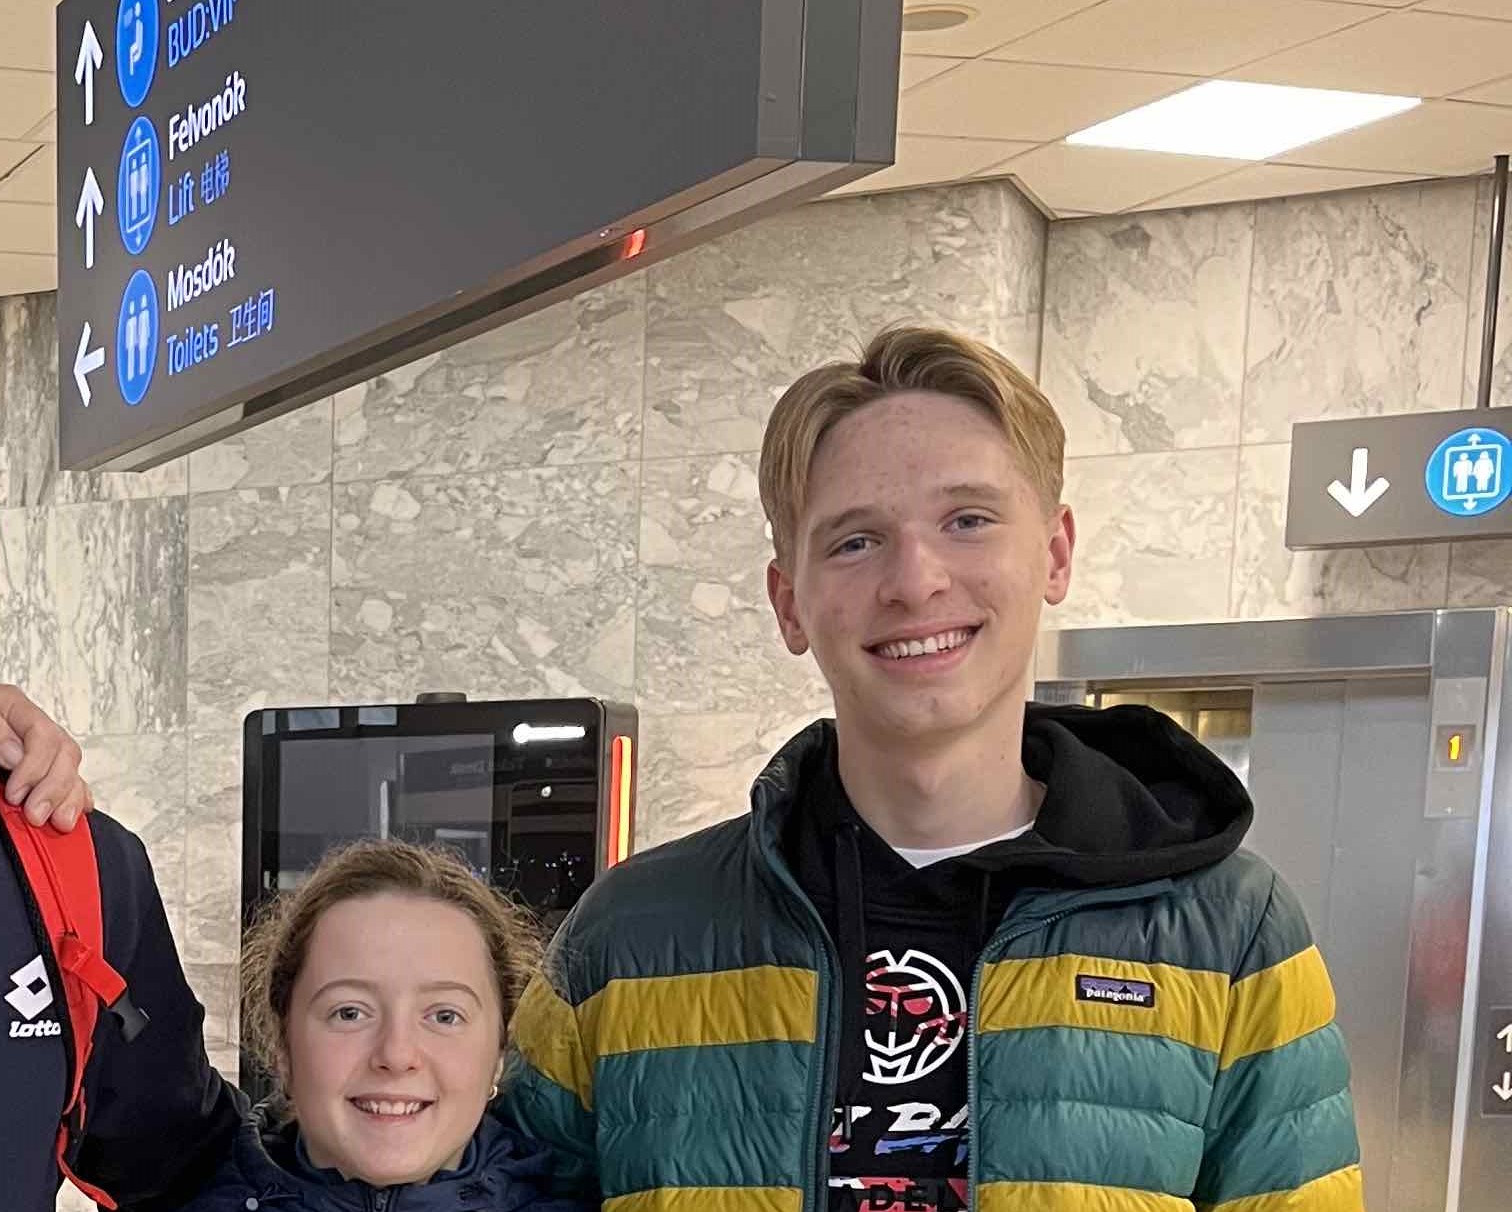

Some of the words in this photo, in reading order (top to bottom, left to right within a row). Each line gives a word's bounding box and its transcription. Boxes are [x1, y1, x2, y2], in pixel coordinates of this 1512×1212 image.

[168, 71, 246, 160] Felvonók
[168, 170, 195, 225] Lift
[167, 238, 235, 312] Mosdók
[166, 323, 219, 376] Toilets
[227, 288, 274, 348] 卫生间
[1449, 735, 1461, 760] 1
